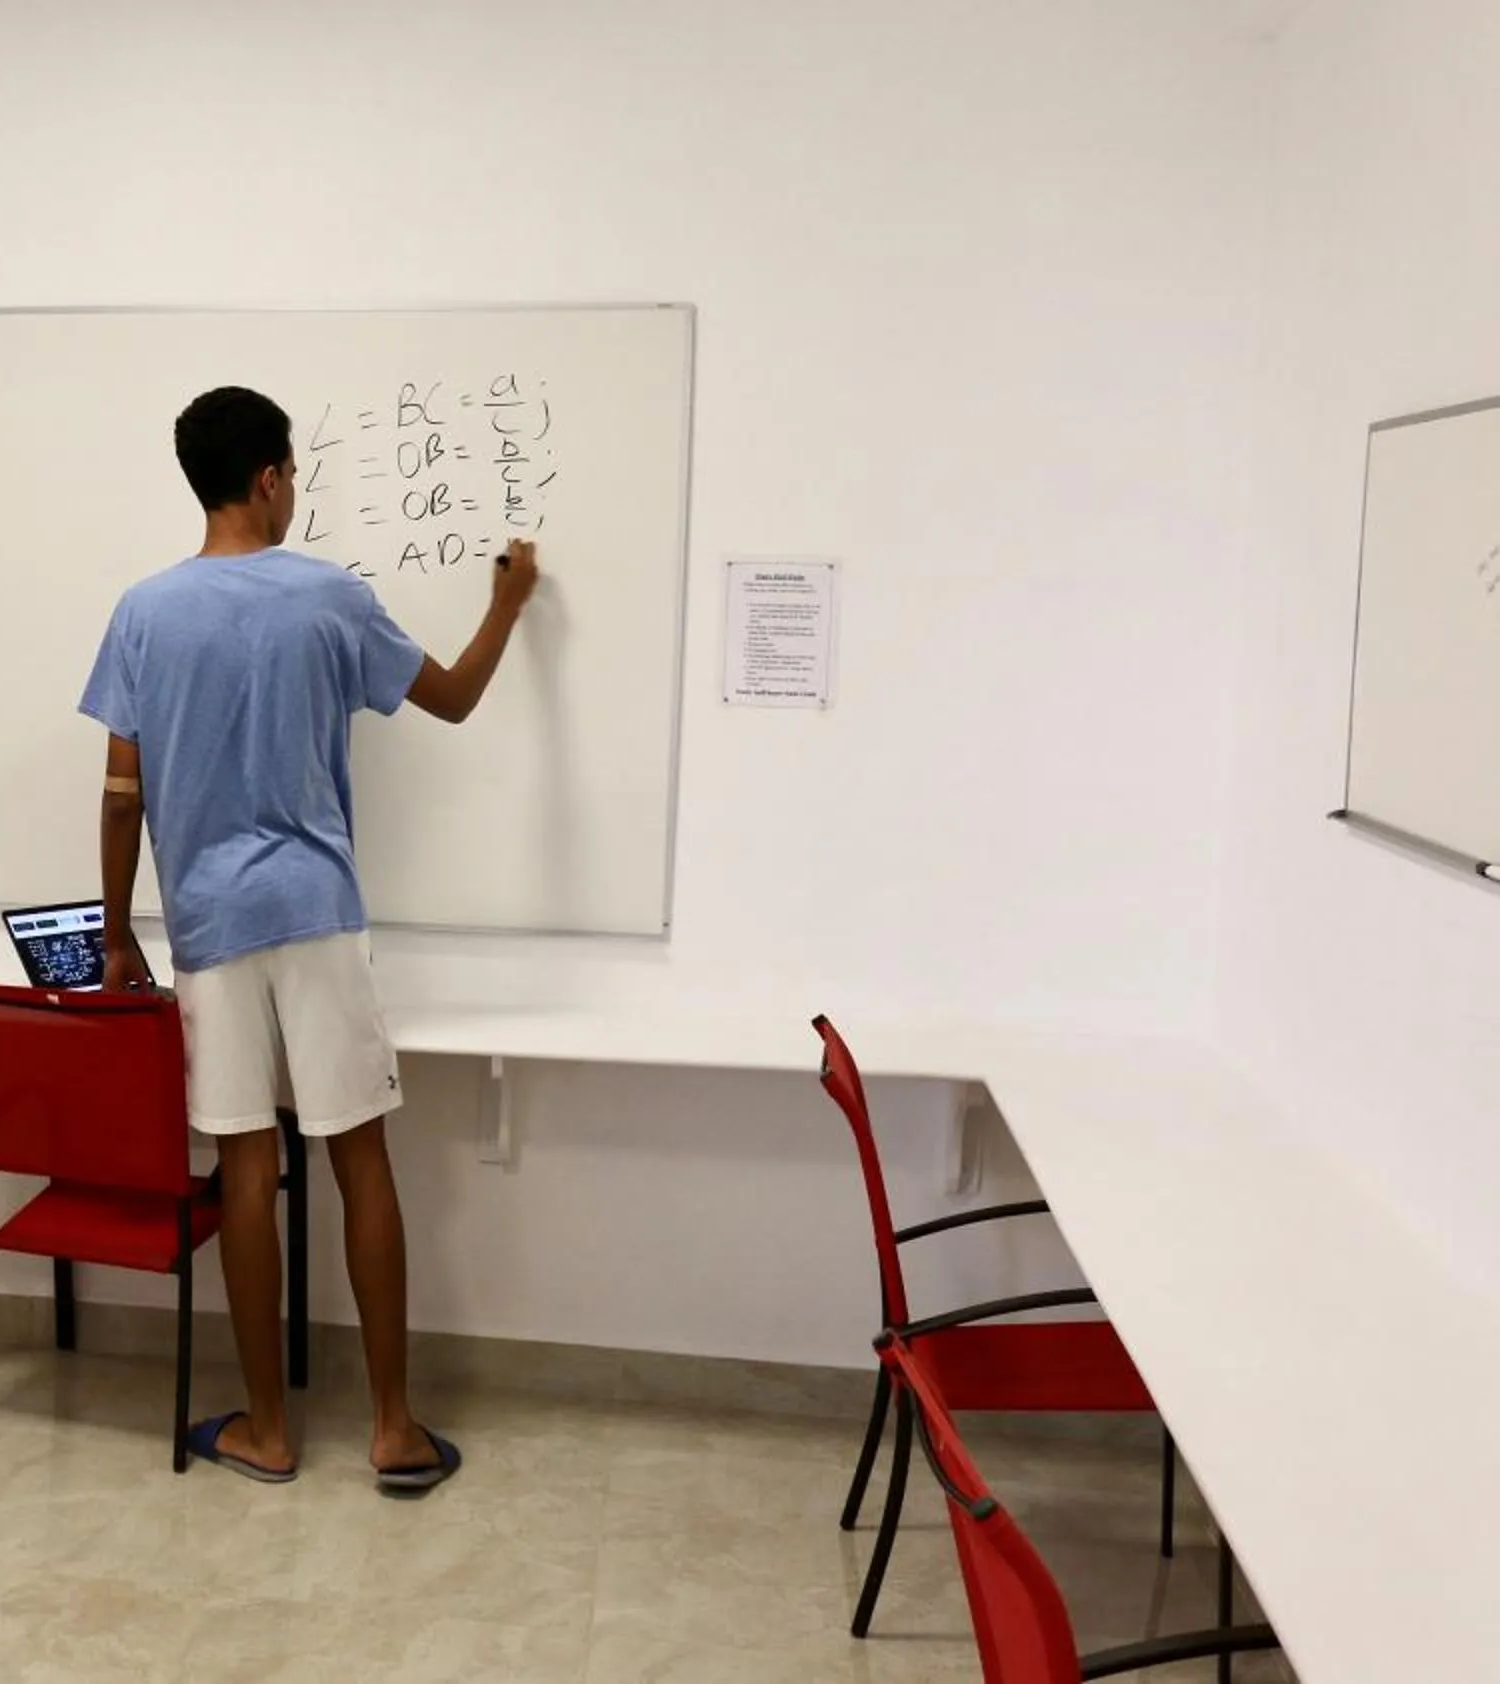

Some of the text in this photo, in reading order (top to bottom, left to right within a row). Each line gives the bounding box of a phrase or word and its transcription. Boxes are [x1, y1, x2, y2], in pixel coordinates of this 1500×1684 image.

[397, 382, 446, 428] BC
[397, 432, 445, 479] OB
[401, 483, 451, 521] OB
